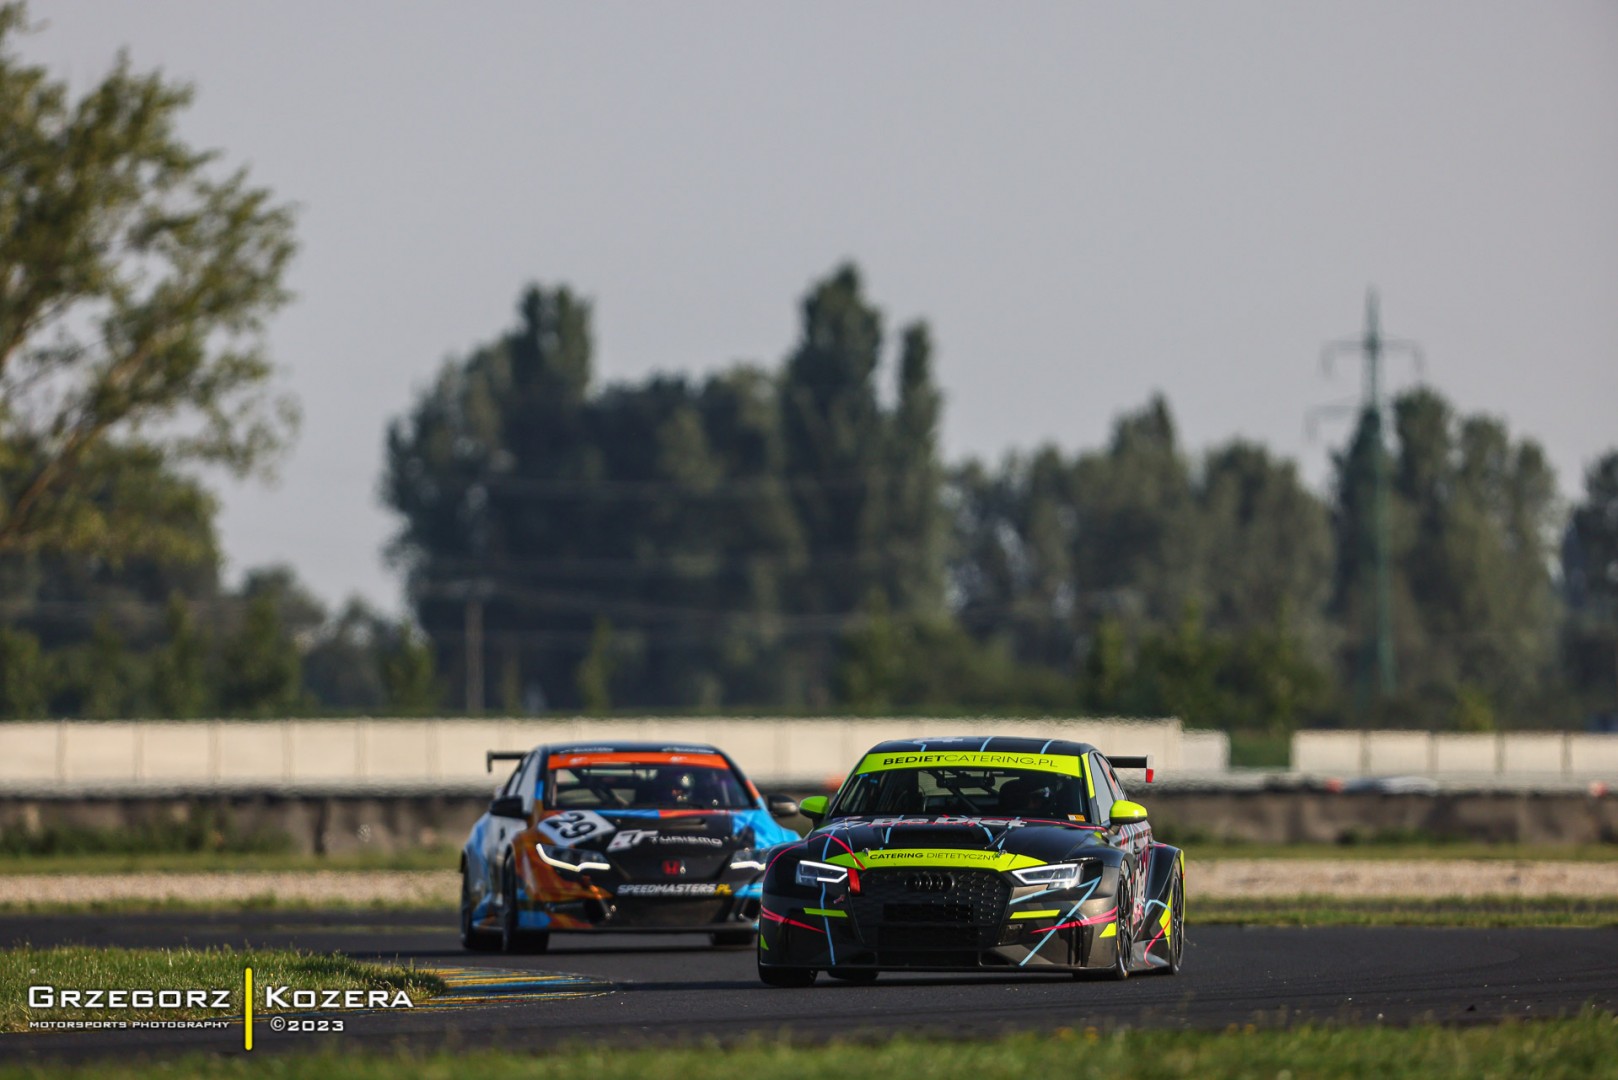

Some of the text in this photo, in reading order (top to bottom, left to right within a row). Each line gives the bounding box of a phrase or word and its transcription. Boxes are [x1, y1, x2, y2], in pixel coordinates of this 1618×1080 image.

[883, 754, 1058, 767] BEDIETCATERING.PL
[545, 812, 597, 839] 29
[869, 852, 998, 861] CATERING DIETETYCZNY
[617, 884, 732, 896] SPEEDMASTERS.PL
